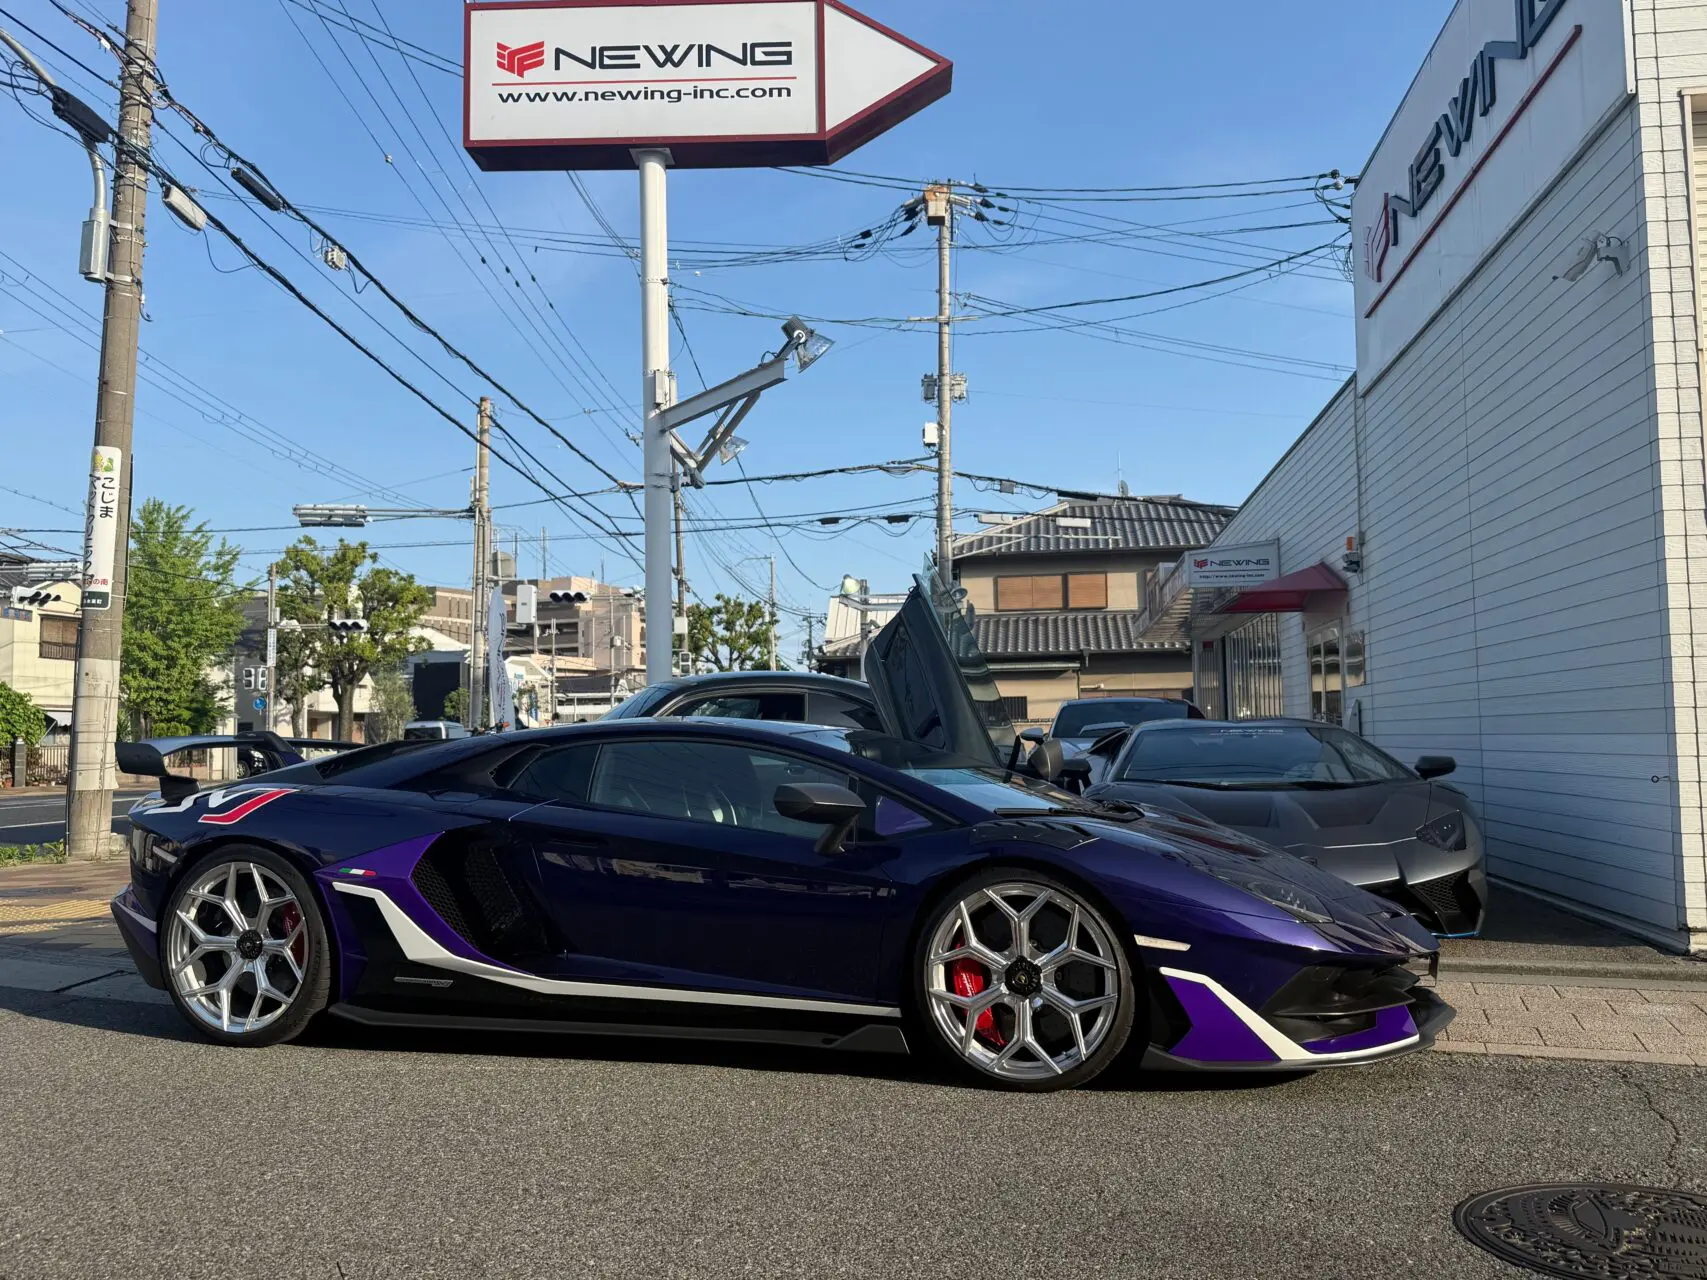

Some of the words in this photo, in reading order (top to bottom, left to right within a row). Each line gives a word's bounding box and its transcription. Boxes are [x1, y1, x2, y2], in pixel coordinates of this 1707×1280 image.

[554, 41, 793, 71] NEWING
[497, 85, 792, 103] www.newing-inc.com
[100, 476, 116, 519] こじま
[1209, 558, 1270, 567] NEWING
